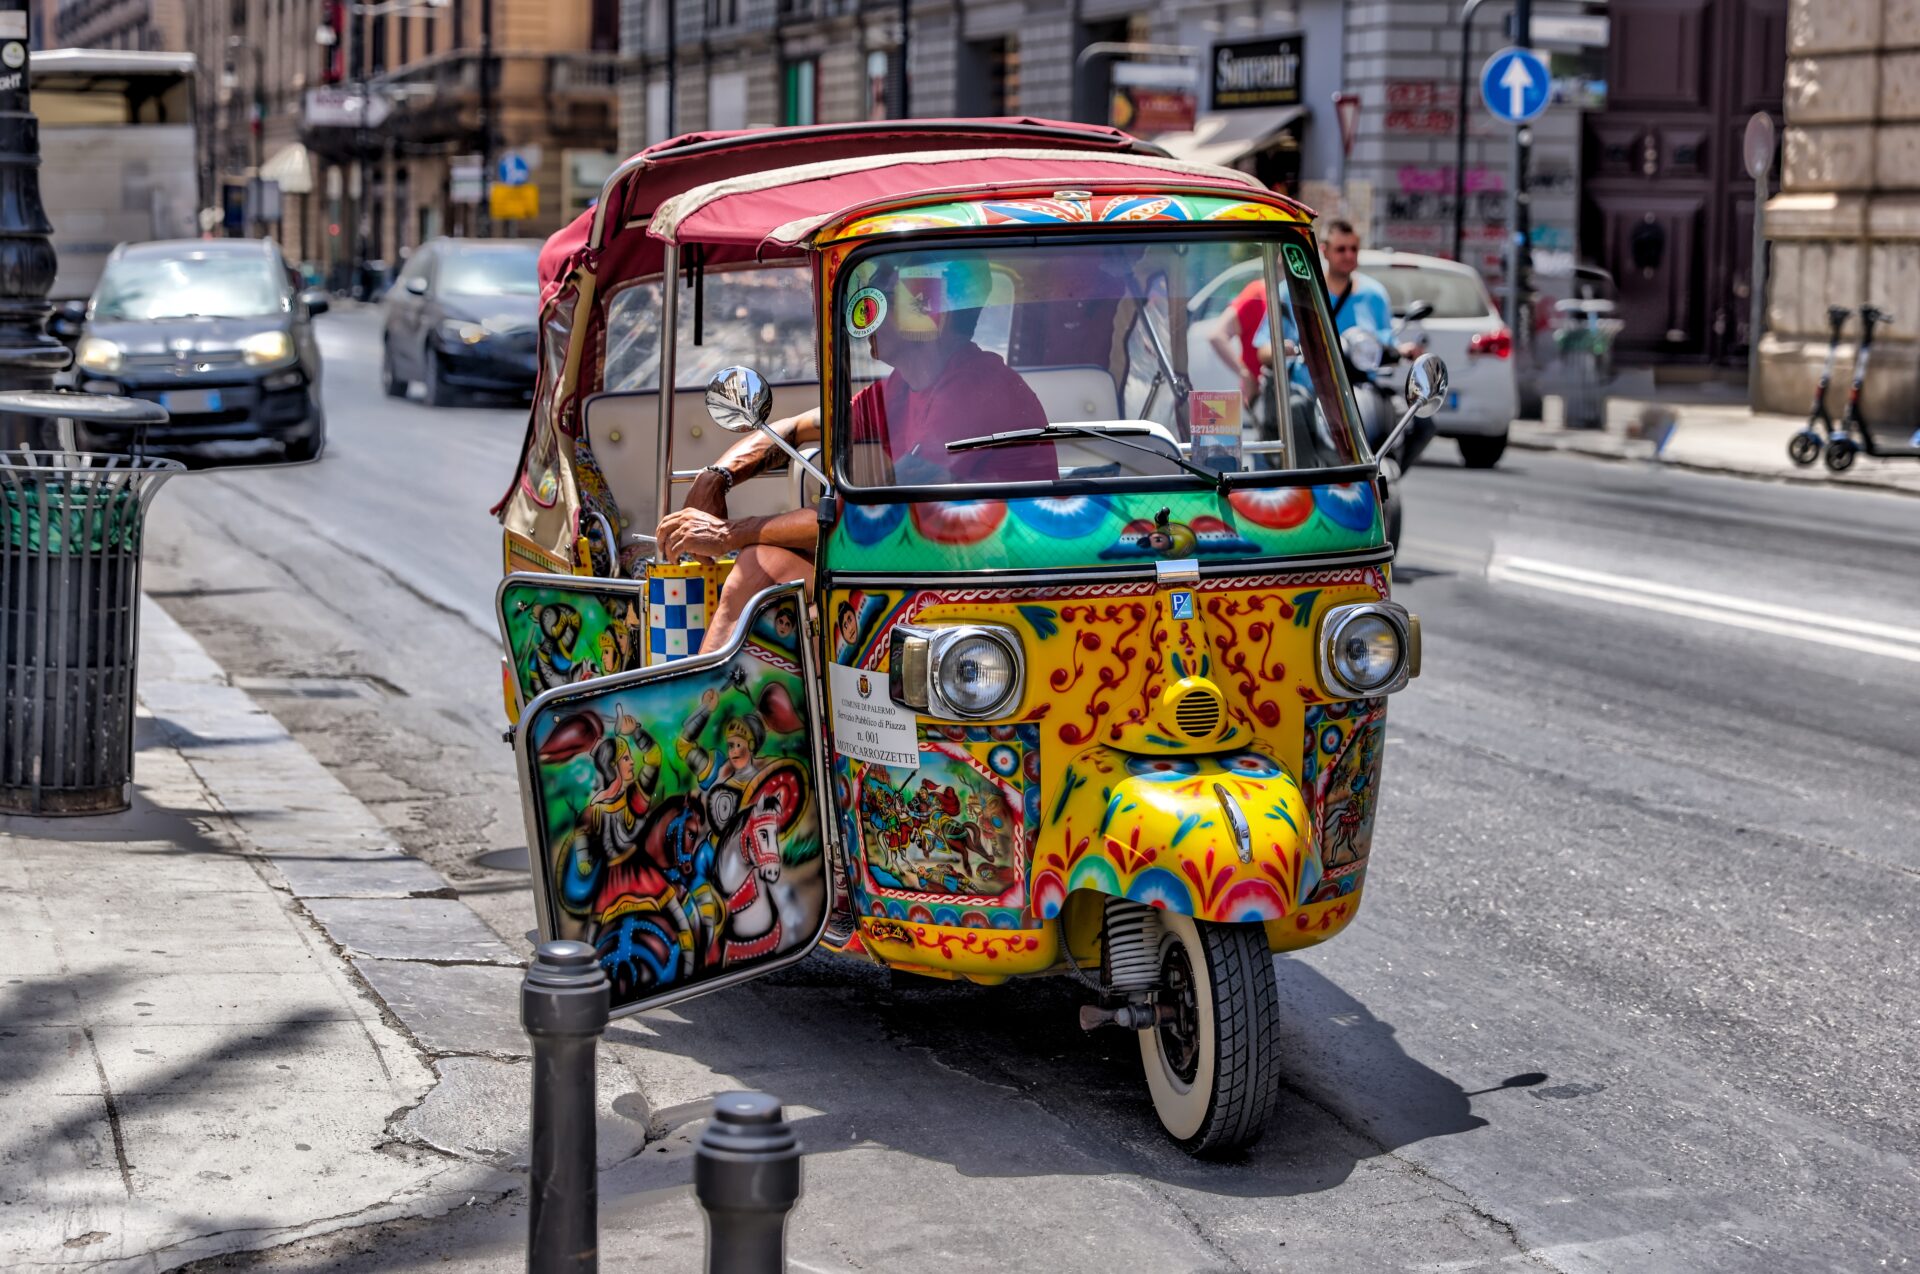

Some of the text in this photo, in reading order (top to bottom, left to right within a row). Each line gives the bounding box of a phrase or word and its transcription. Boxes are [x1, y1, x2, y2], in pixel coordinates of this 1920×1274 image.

[1216, 42, 1300, 91] Souvenir
[1173, 595, 1184, 611] P
[841, 699, 895, 715] COMUNE DI PALERMO
[837, 710, 906, 731] Servizio Pubblico di Piazza
[857, 731, 879, 744] n. 001
[836, 739, 916, 764] MOTOCARROZZETTE
